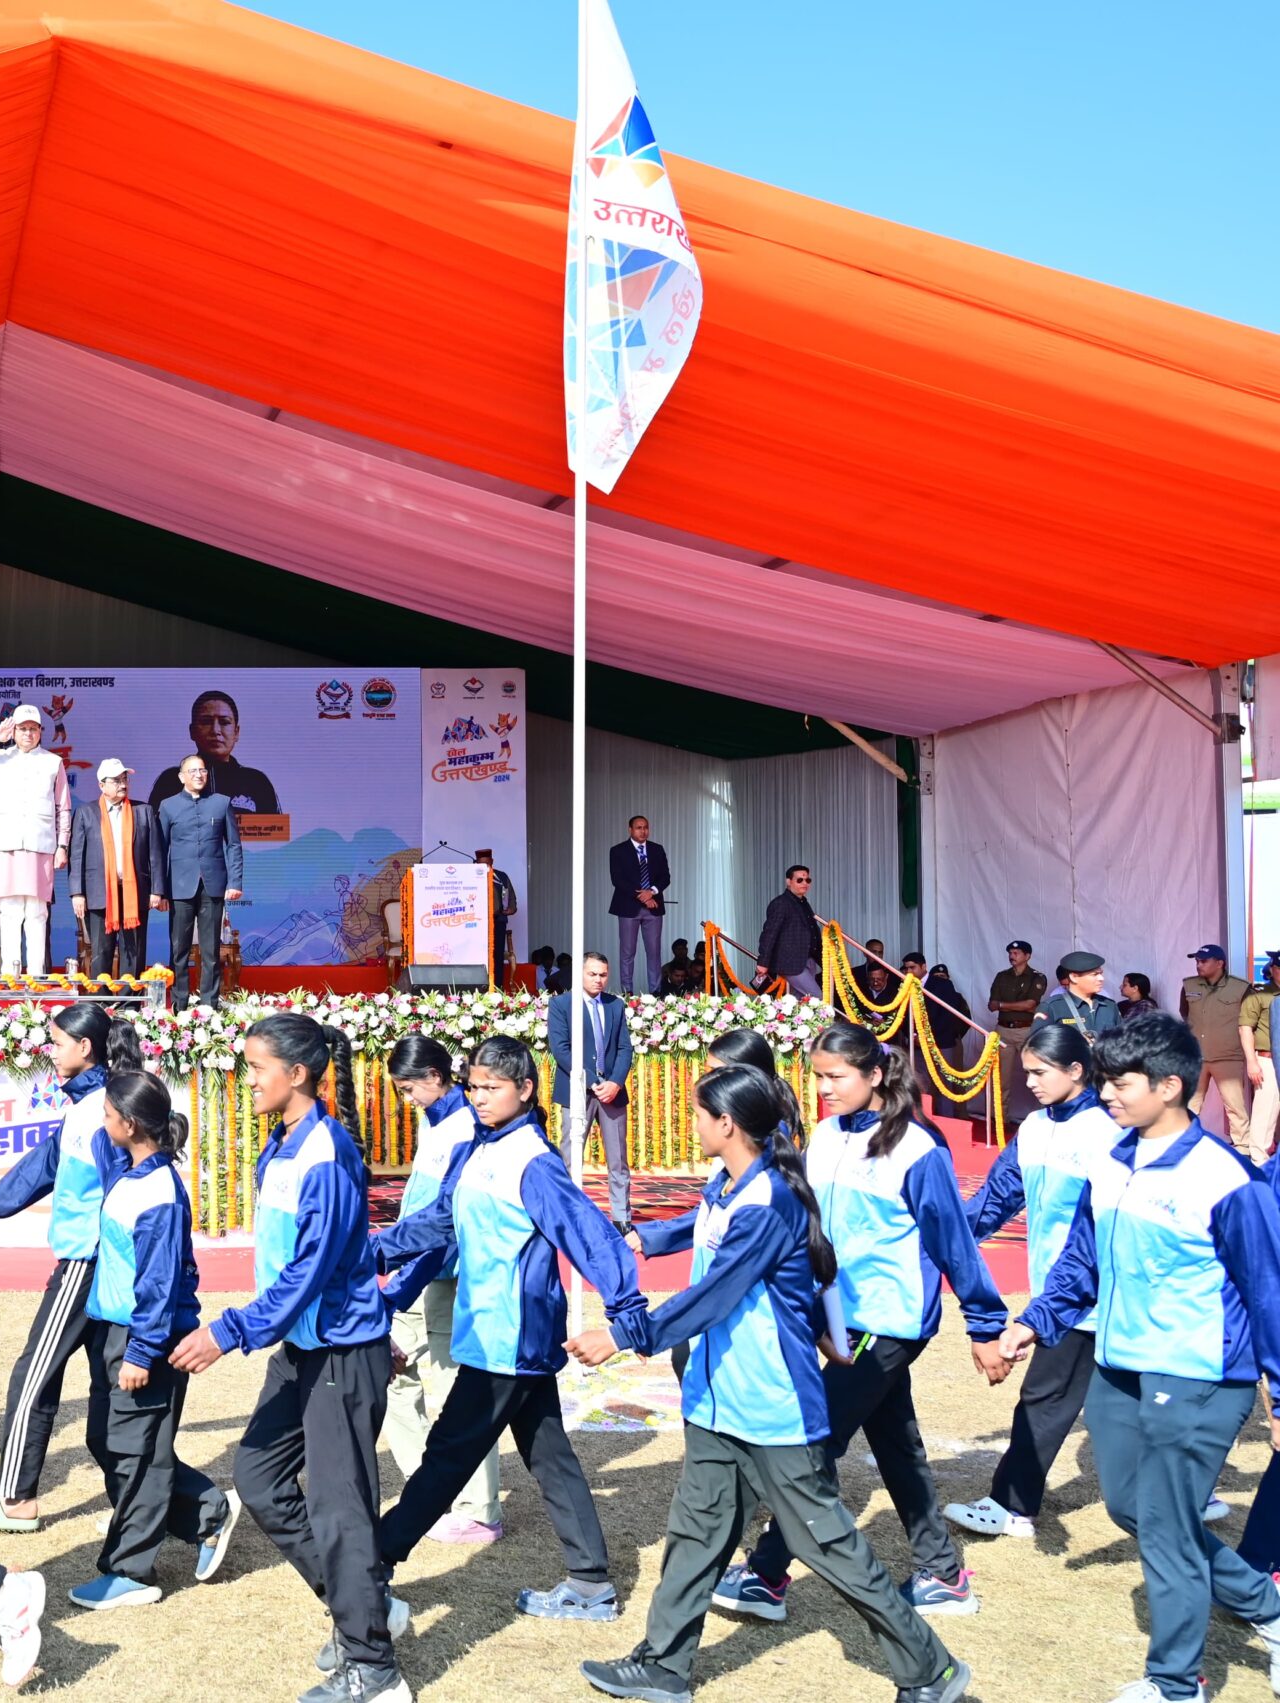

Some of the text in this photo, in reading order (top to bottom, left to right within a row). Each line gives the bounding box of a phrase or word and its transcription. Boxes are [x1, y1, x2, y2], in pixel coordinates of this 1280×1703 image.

[18, 677, 33, 688] दल
[35, 674, 67, 689] विभाग,
[69, 676, 116, 688] उत्तराखण्ड
[446, 747, 467, 757] खेल
[448, 752, 495, 767] महाकुम्भ
[432, 760, 518, 783] उत्तराखण्ड
